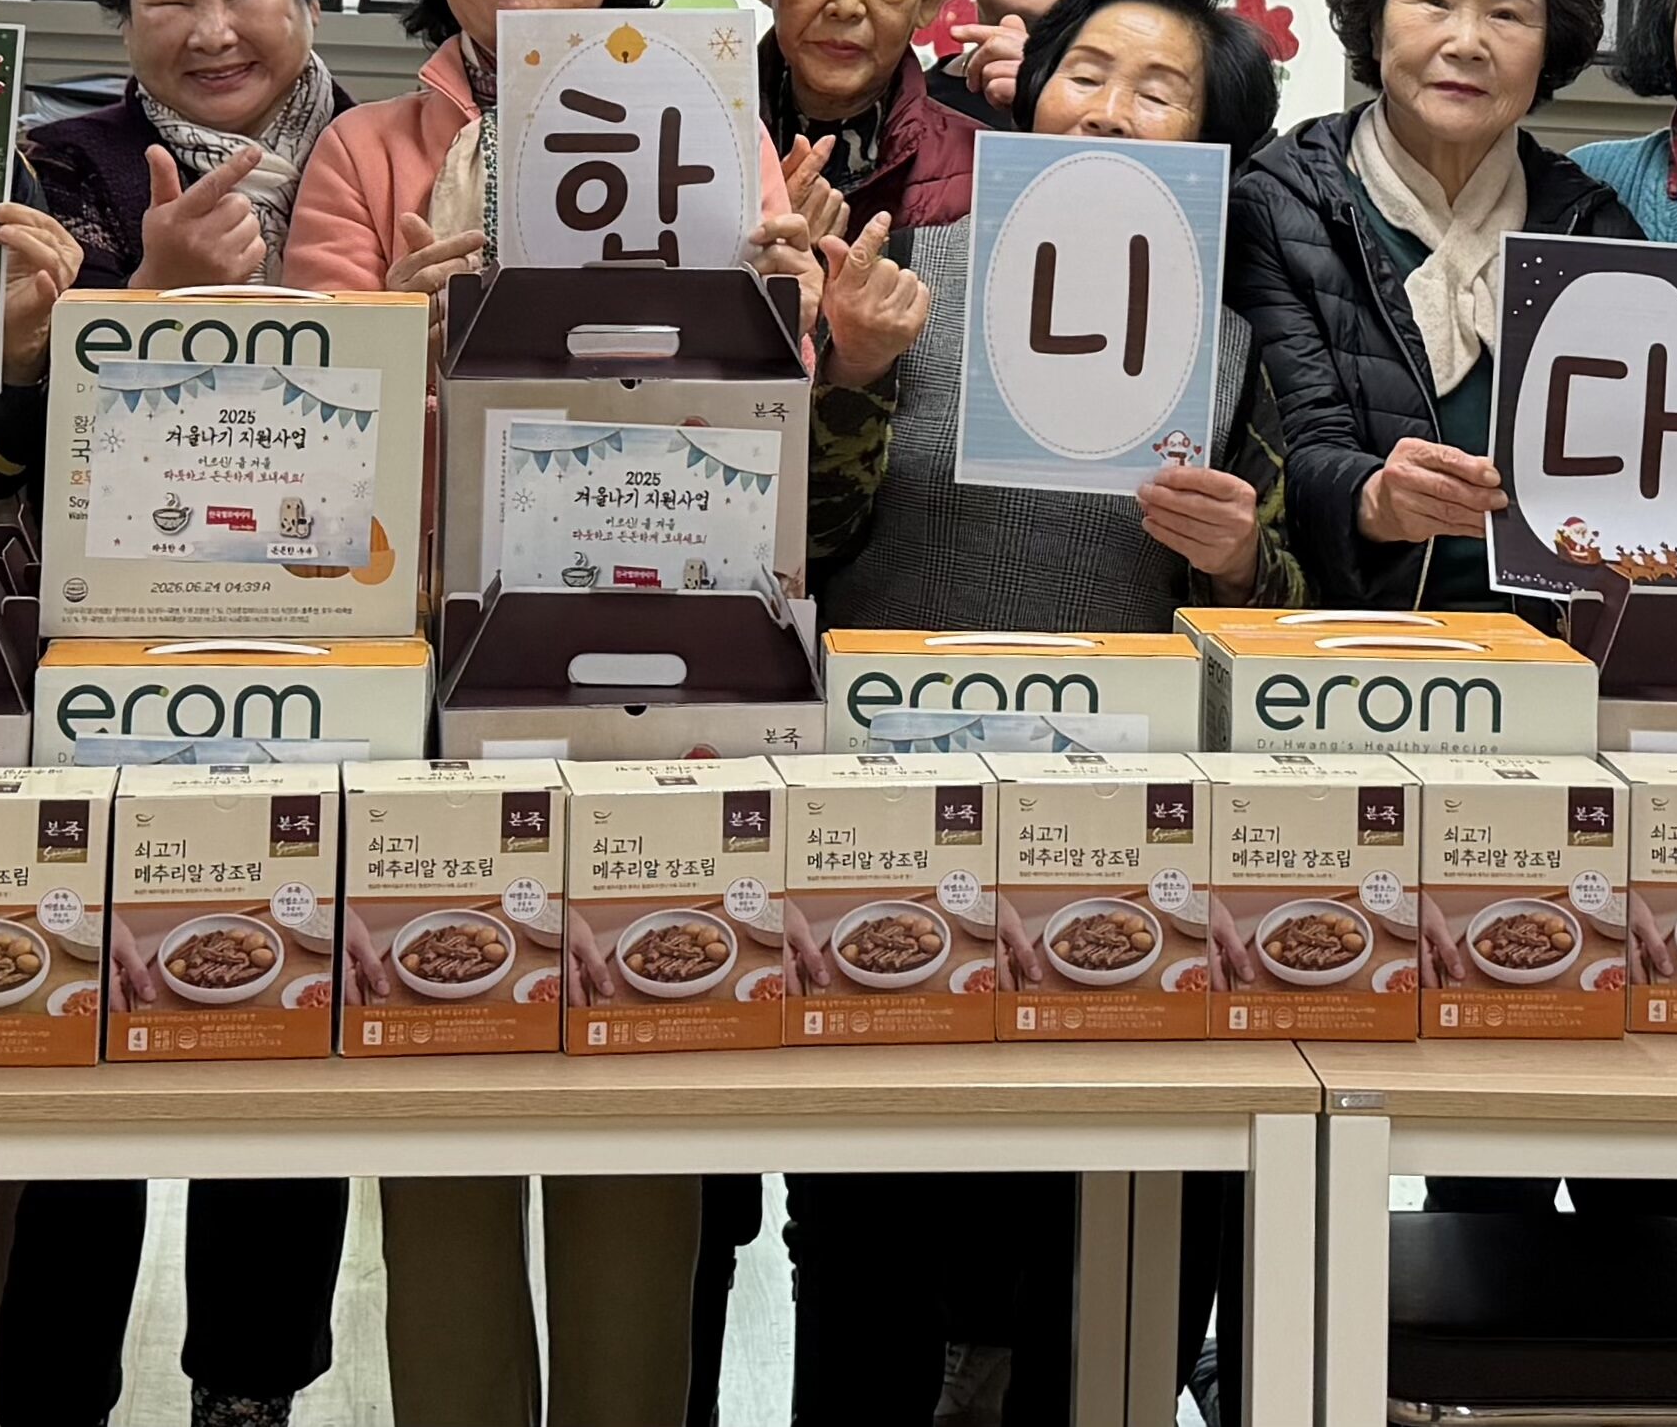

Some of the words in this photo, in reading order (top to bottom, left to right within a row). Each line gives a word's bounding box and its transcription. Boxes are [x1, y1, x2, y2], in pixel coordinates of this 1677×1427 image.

[544, 88, 715, 267] 합
[1028, 234, 1150, 378] 니
[75, 318, 331, 374] erom
[219, 409, 255, 424] 2025
[753, 403, 789, 422] 본죽
[166, 425, 232, 447] 겨울나기
[239, 427, 306, 449] 지원사업
[625, 471, 661, 486] 2025
[574, 486, 638, 508] 겨울나기
[645, 489, 709, 511] 지원사업
[847, 671, 1099, 728] erom
[1256, 674, 1502, 733] erom
[57, 684, 322, 741] erom
[764, 728, 802, 750] 본죽
[1364, 740, 1432, 754] Healthy
[1441, 742, 1499, 754] Recipe
[509, 812, 545, 831] 본죽
[730, 812, 765, 831] 본죽
[943, 805, 977, 824] 본죽
[1154, 803, 1188, 822] 본죽
[1366, 806, 1399, 825] 본죽
[1575, 807, 1609, 826] 본죽
[45, 821, 83, 841] 본죽
[278, 816, 315, 835] 본죽
[1019, 825, 1067, 843] 쇠고기
[1232, 825, 1279, 844] 쇠고기
[1444, 826, 1491, 844] 쇠고기
[369, 835, 418, 854] 쇠고기
[593, 836, 642, 855] 쇠고기
[807, 827, 855, 846] 쇠고기
[135, 839, 186, 859] 쇠고기
[1020, 848, 1085, 867] 메추리알
[1091, 848, 1139, 867] 장조림
[1233, 849, 1297, 868] 메추리알
[1303, 849, 1350, 868] 장조림
[1444, 849, 1508, 867] 메추리알
[1514, 850, 1560, 868] 장조림
[369, 859, 437, 878] 메추리알
[443, 857, 493, 878] 장조림
[593, 859, 660, 879] 메추리알
[666, 858, 715, 878] 장조림
[808, 851, 874, 870] 메추리알
[879, 850, 927, 869] 장조림
[135, 864, 204, 883] 메추리알
[210, 862, 261, 882] 장조림
